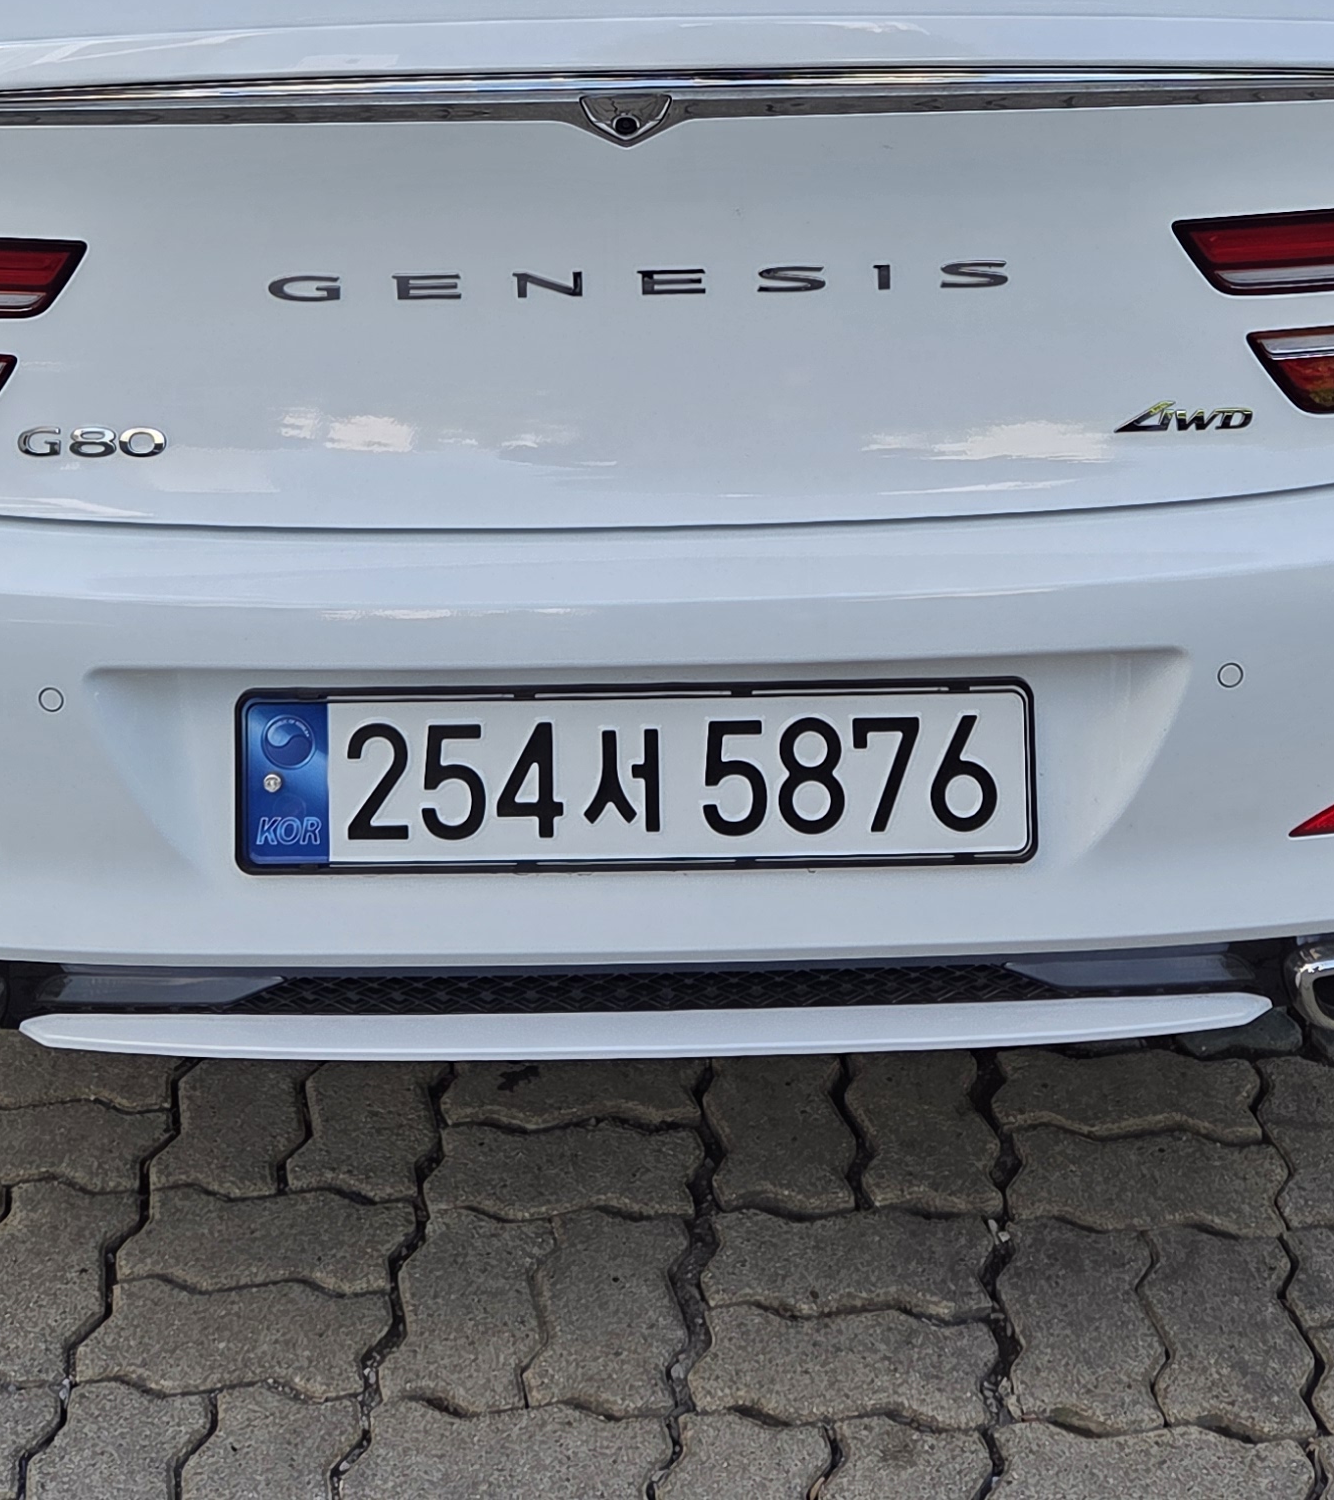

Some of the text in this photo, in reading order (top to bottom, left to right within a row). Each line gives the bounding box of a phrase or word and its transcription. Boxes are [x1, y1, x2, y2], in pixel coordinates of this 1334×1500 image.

[269, 259, 1010, 302] GENESIS
[1113, 399, 1254, 433] 4WD
[17, 425, 168, 458] G80
[345, 713, 999, 842] 254서 5876
[255, 816, 323, 846] KOR
